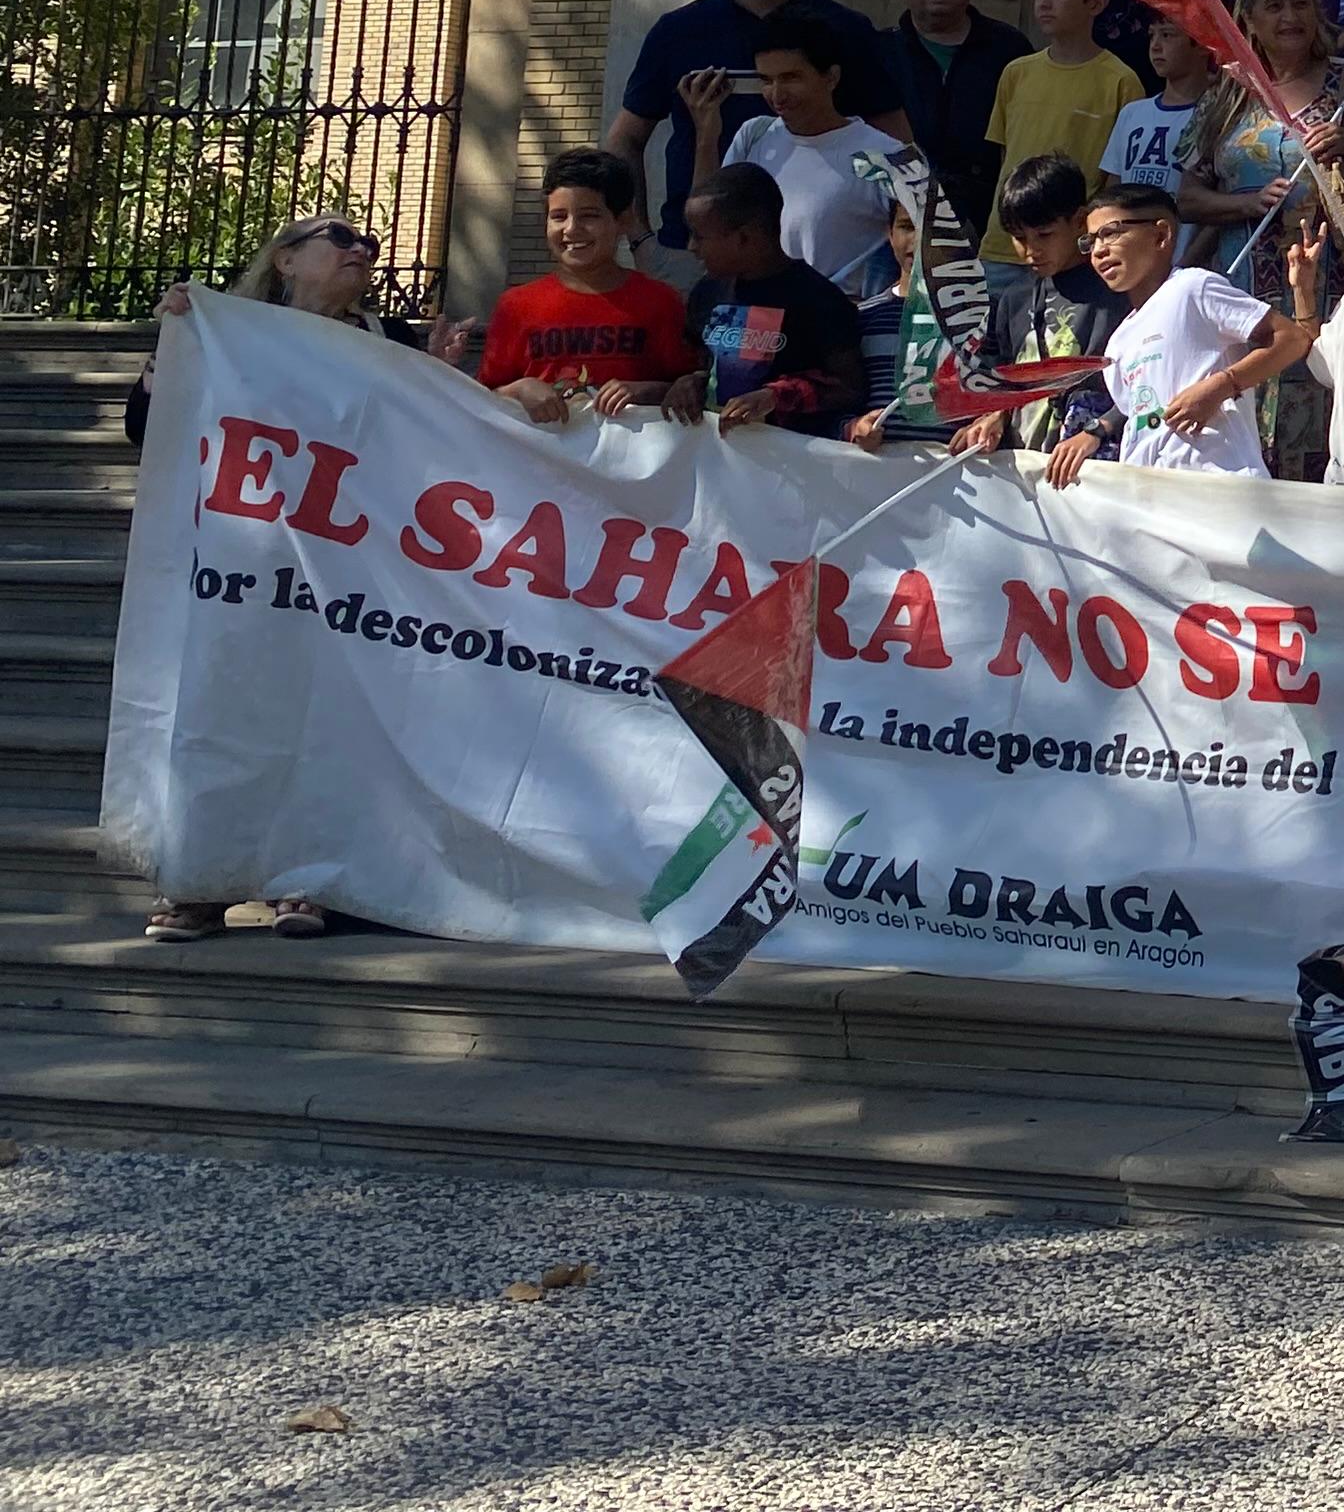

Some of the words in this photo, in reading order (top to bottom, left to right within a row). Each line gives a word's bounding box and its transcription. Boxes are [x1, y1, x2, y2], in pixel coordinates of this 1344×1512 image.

[1124, 126, 1184, 171] GA
[1134, 170, 1166, 186] 1969
[194, 416, 370, 546] EL
[399, 481, 954, 670] SAHARA
[987, 580, 1151, 690] NO
[1173, 604, 1322, 706] SE
[190, 546, 257, 604] or
[271, 566, 320, 614] la
[817, 701, 865, 741] la
[879, 707, 1248, 788] independencia
[1262, 748, 1338, 796] del
[794, 897, 870, 925] Amigos
[875, 908, 910, 930] del
[916, 916, 987, 941] Pueblo
[992, 924, 1087, 954] Saharaui
[1094, 937, 1121, 957] en
[1126, 939, 1205, 969] Aragón
[822, 851, 926, 910] UM
[946, 867, 1203, 940] DRAIGA
